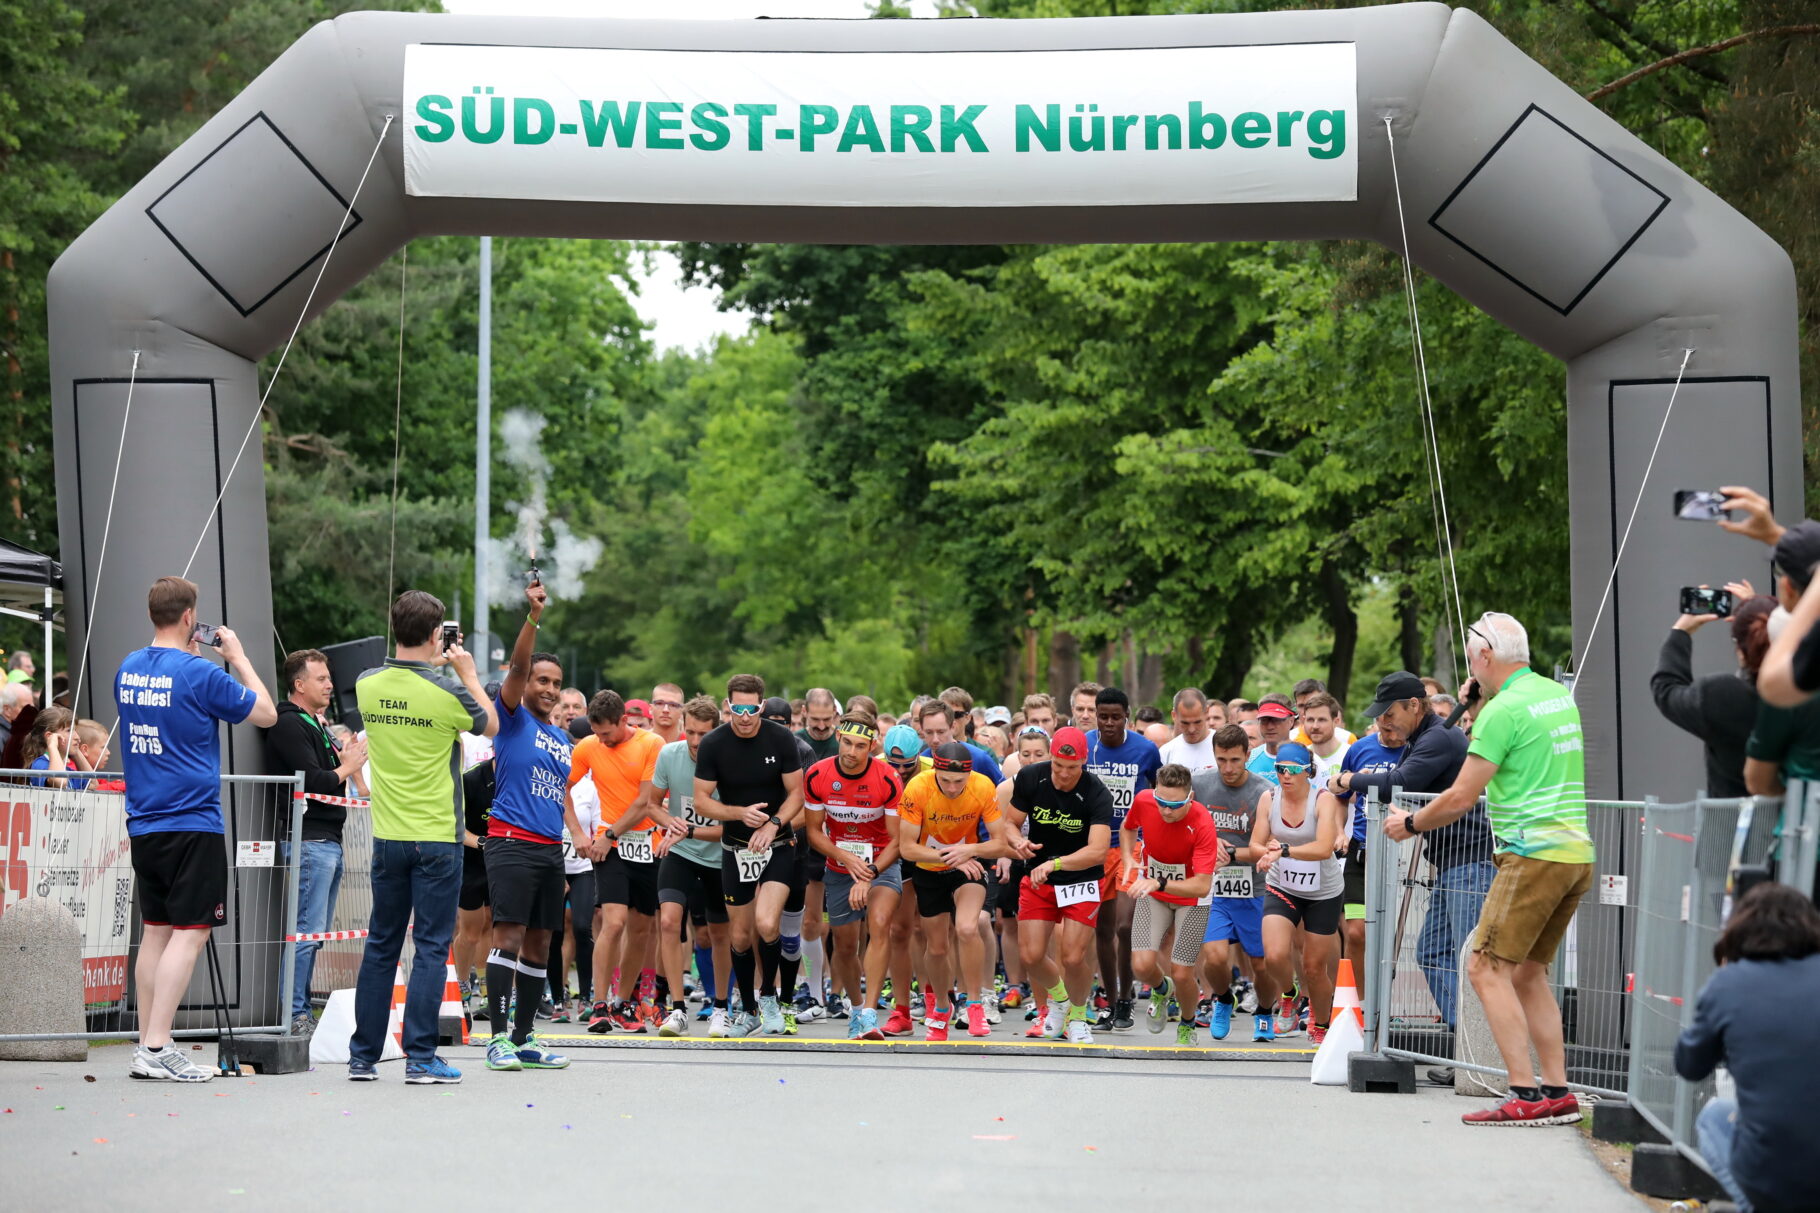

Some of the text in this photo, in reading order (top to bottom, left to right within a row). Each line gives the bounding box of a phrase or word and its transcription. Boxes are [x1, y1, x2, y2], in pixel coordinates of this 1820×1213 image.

[414, 86, 1346, 160] SÜD-WEST-PARK Nürnberg
[120, 672, 172, 689] Dabei sein
[119, 687, 171, 708] ist alles!
[379, 699, 408, 711] TEAM
[129, 722, 159, 737] FunRun
[130, 735, 163, 755] 2019
[1111, 763, 1139, 776] 2019
[531, 782, 565, 805] HOTE
[1111, 788, 1132, 807] 20
[619, 841, 652, 861] 1043
[47, 866, 79, 888] teinmetze
[1283, 869, 1317, 886] 1777
[1061, 882, 1096, 899] 1776
[1214, 879, 1251, 897] 1449
